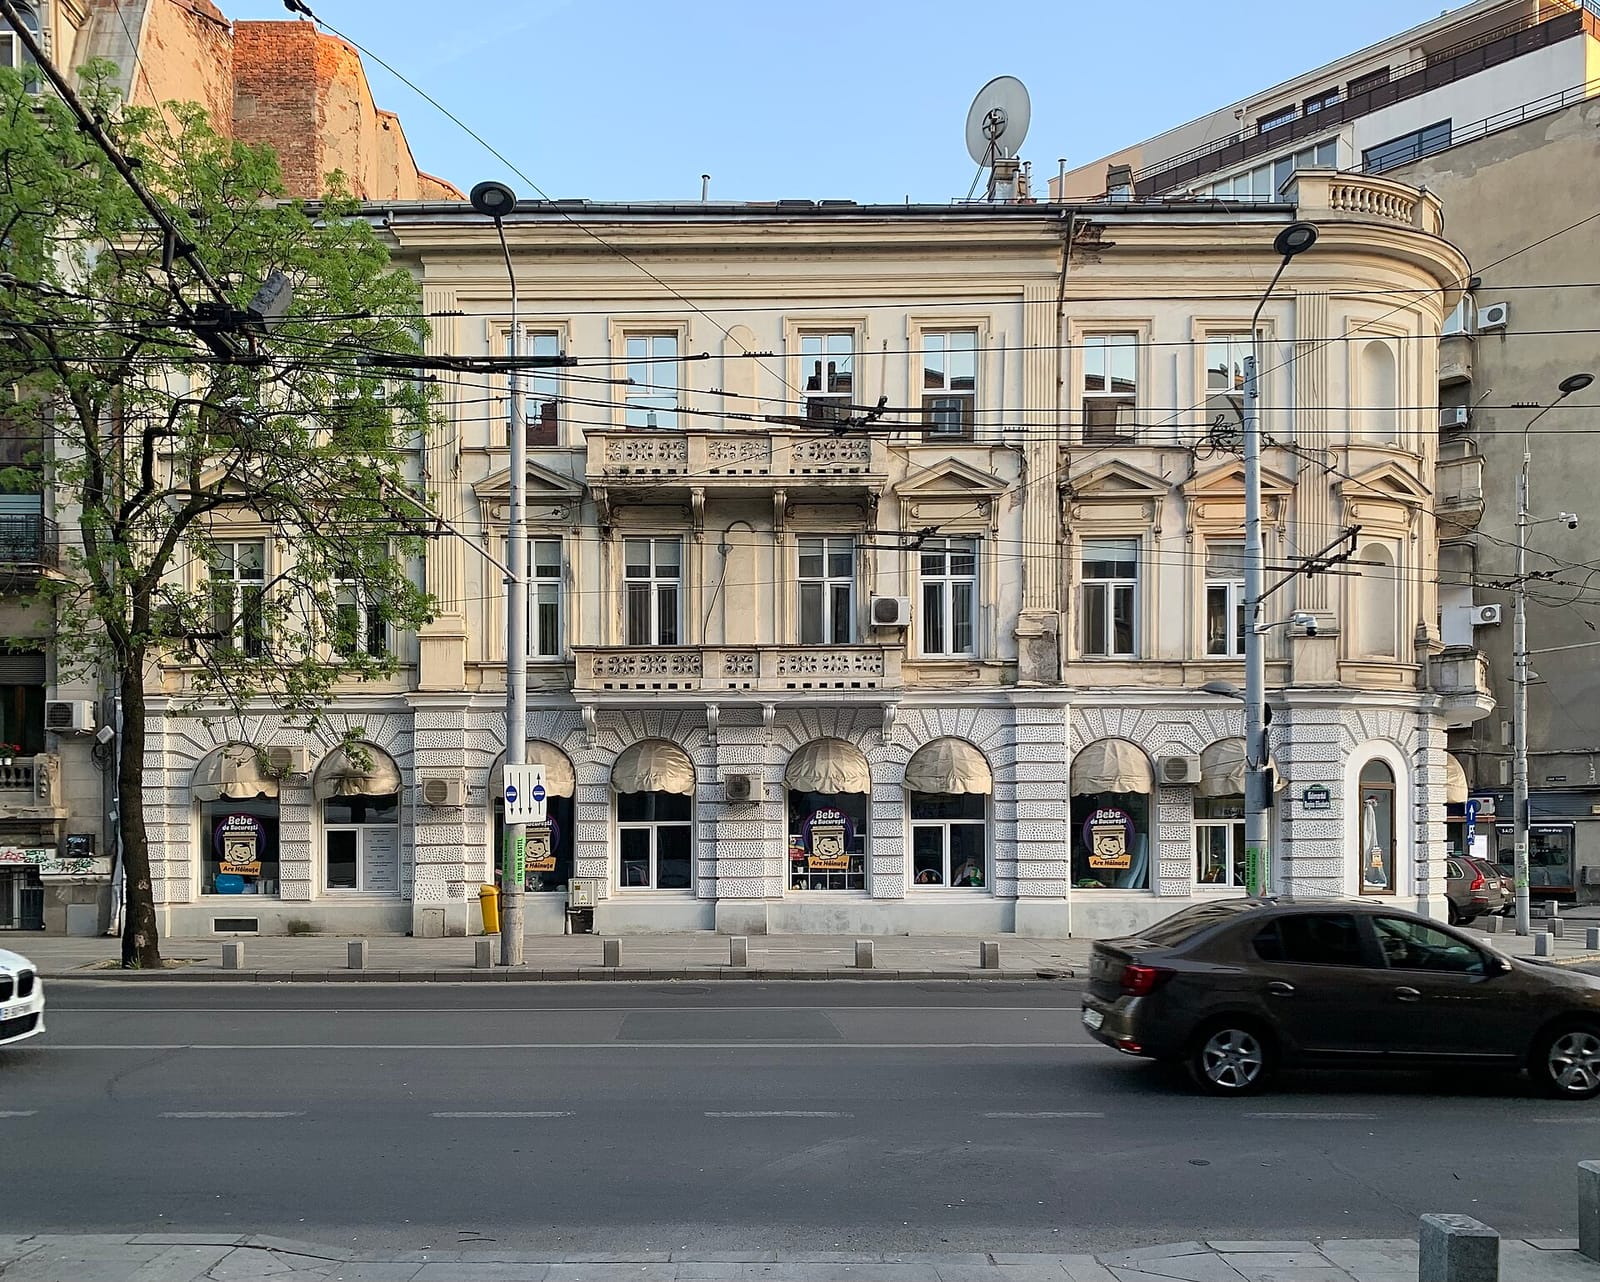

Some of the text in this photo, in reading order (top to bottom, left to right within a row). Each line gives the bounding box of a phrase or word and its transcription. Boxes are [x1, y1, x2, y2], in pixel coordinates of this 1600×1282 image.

[815, 810, 840, 820] Bebe
[1096, 809, 1121, 819] Bebe
[228, 815, 253, 825] Bebe
[222, 823, 230, 831] de
